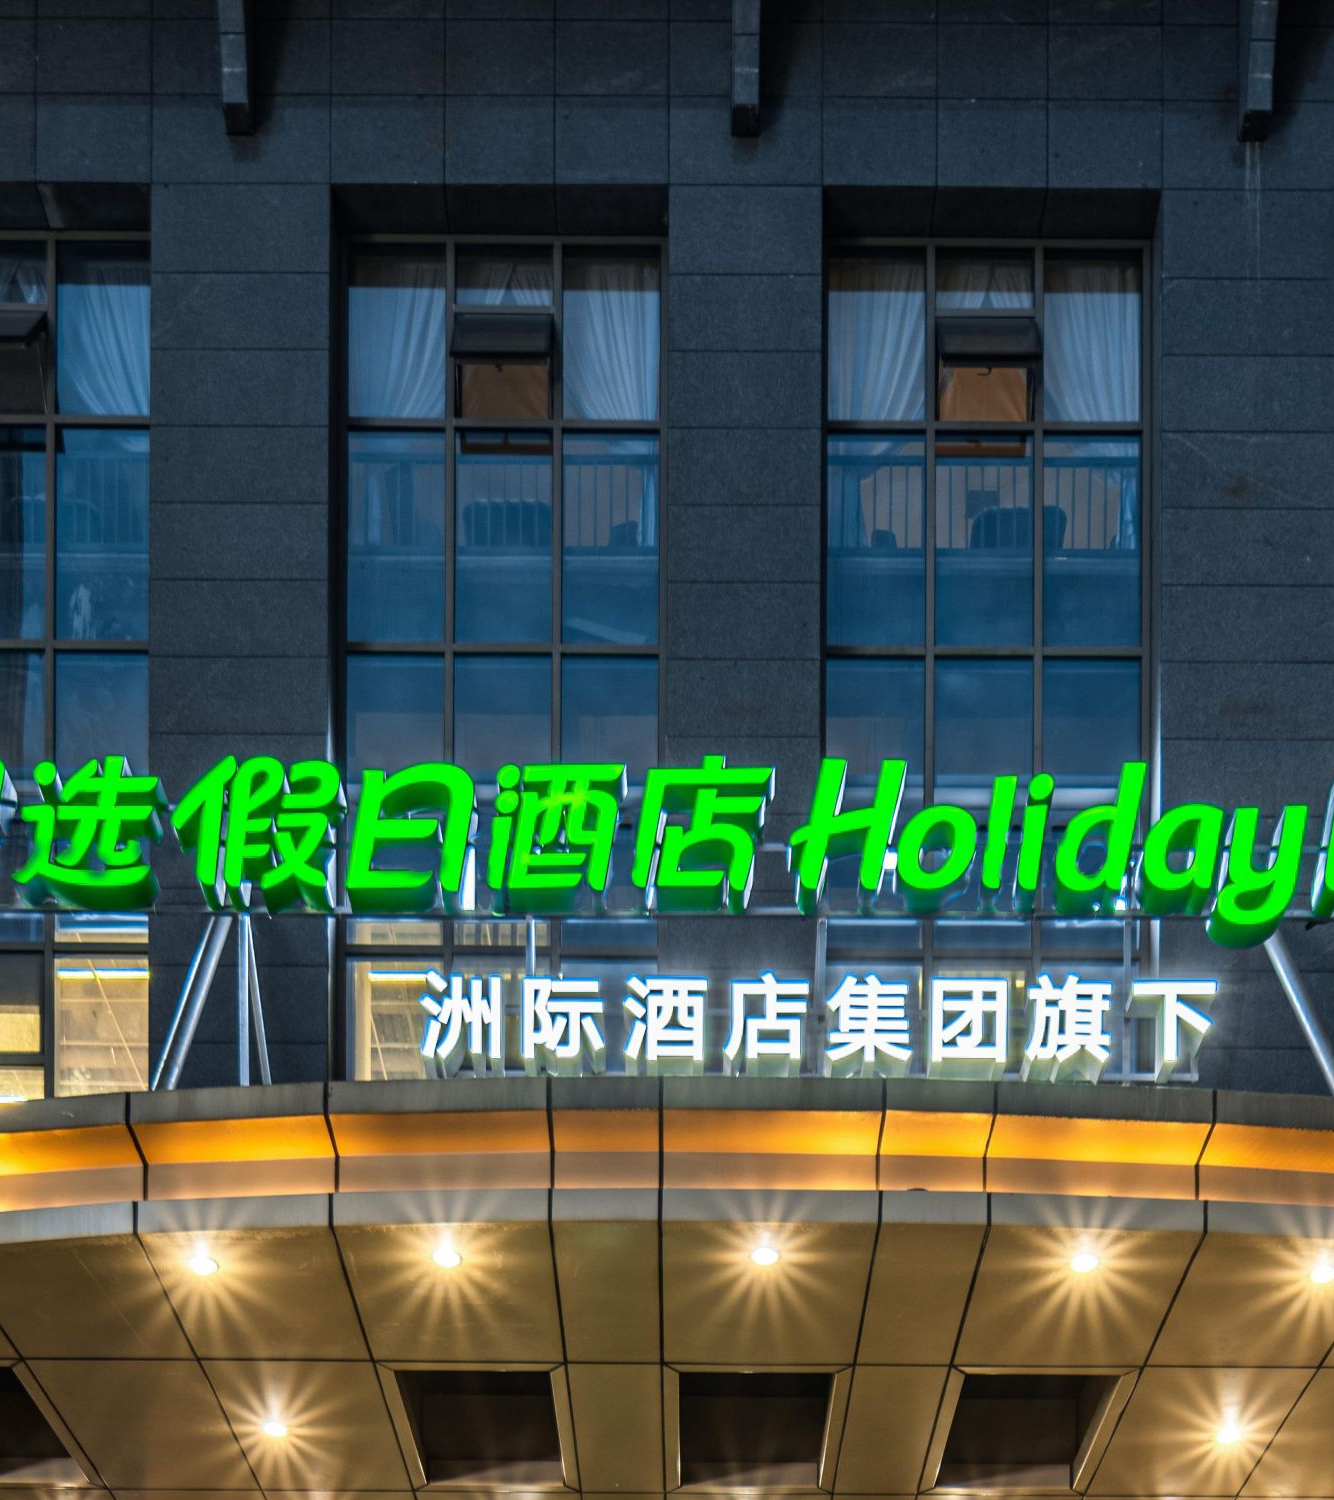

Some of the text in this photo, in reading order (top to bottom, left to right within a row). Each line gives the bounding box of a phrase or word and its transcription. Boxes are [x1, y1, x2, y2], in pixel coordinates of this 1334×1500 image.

[419, 972, 1218, 1064] 洲际酒店集团旗下
